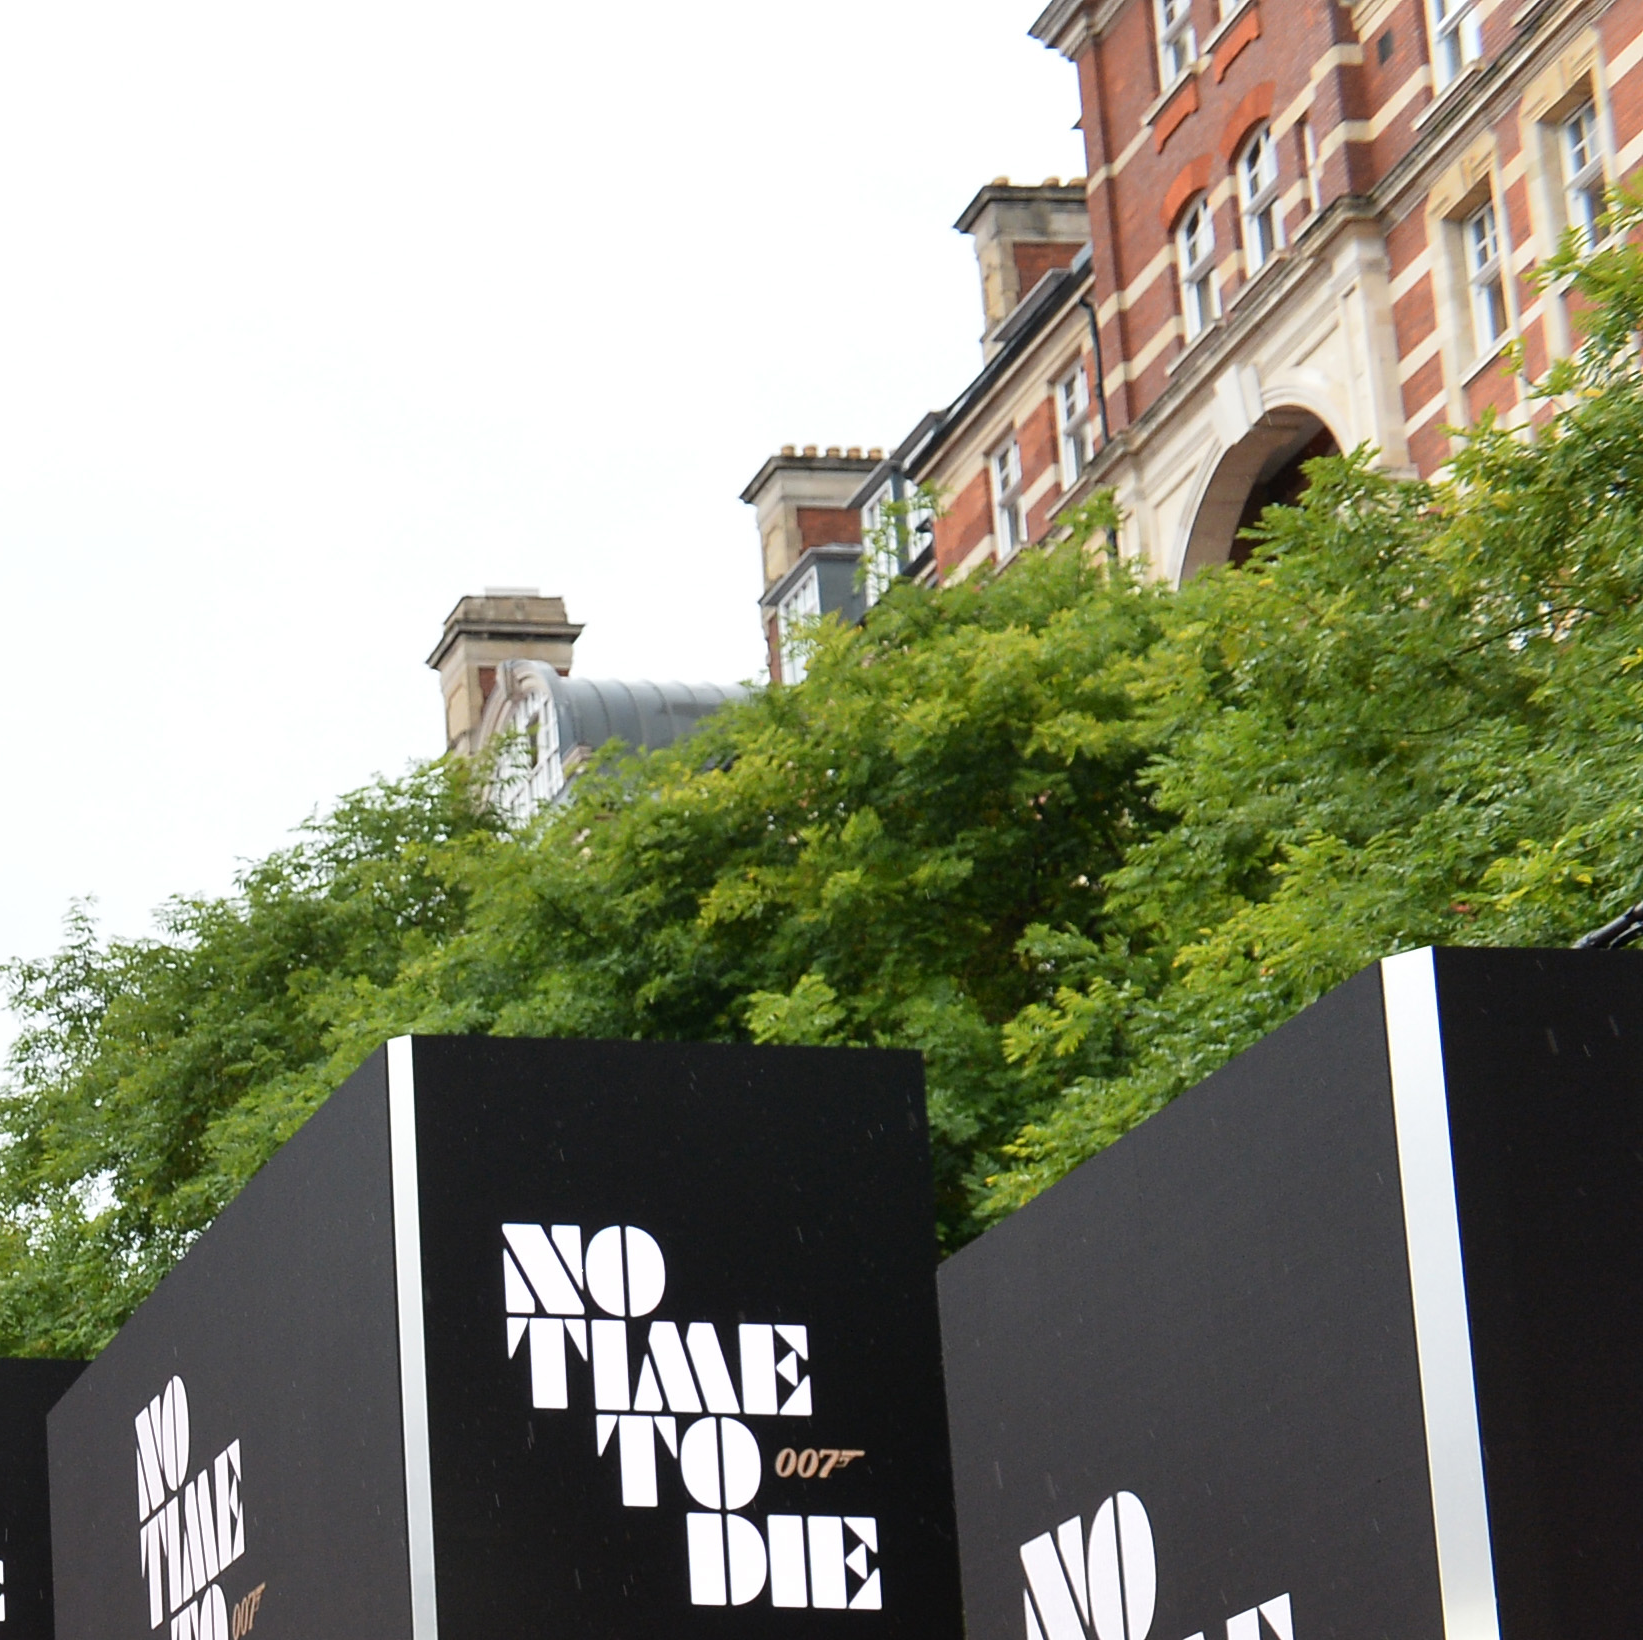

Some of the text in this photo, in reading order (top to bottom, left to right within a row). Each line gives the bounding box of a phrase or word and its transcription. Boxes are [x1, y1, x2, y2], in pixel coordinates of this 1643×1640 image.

[502, 1224, 665, 1317] NO
[507, 1317, 812, 1415] TIME
[135, 1376, 189, 1522] NO
[596, 1415, 761, 1510] TO
[774, 1448, 865, 1479] 007
[141, 1439, 244, 1629] TIME
[687, 1513, 882, 1609] DIE
